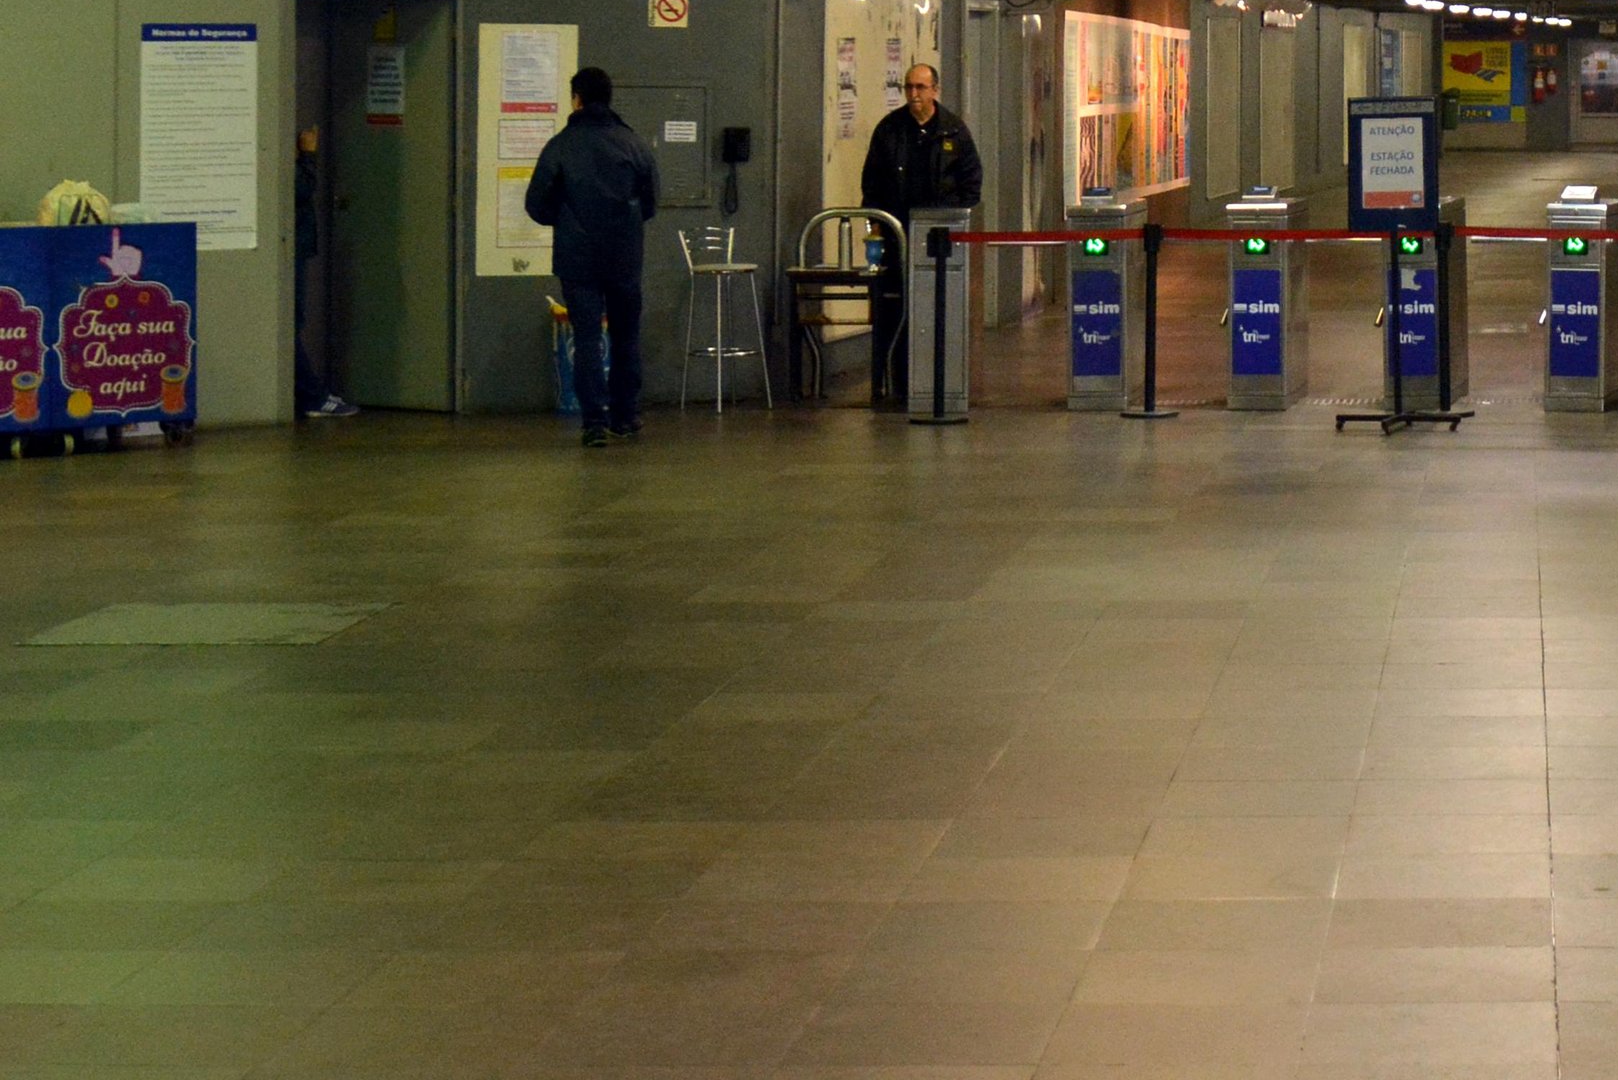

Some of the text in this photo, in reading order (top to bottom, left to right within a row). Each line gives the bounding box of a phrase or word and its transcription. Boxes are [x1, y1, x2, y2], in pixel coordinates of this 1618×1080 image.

[152, 28, 248, 38] Normas de Segurança
[1370, 125, 1415, 136] ATENÇÃO
[1371, 150, 1414, 162] ESTAÇÃO
[1370, 165, 1414, 175] FECHADA
[1089, 301, 1120, 314] sim
[1249, 300, 1280, 313] sim
[1404, 301, 1435, 314] sim
[1567, 302, 1598, 315] sim
[73, 309, 175, 341] Faça sua
[83, 341, 166, 370] Doação
[100, 373, 148, 400] aqui
